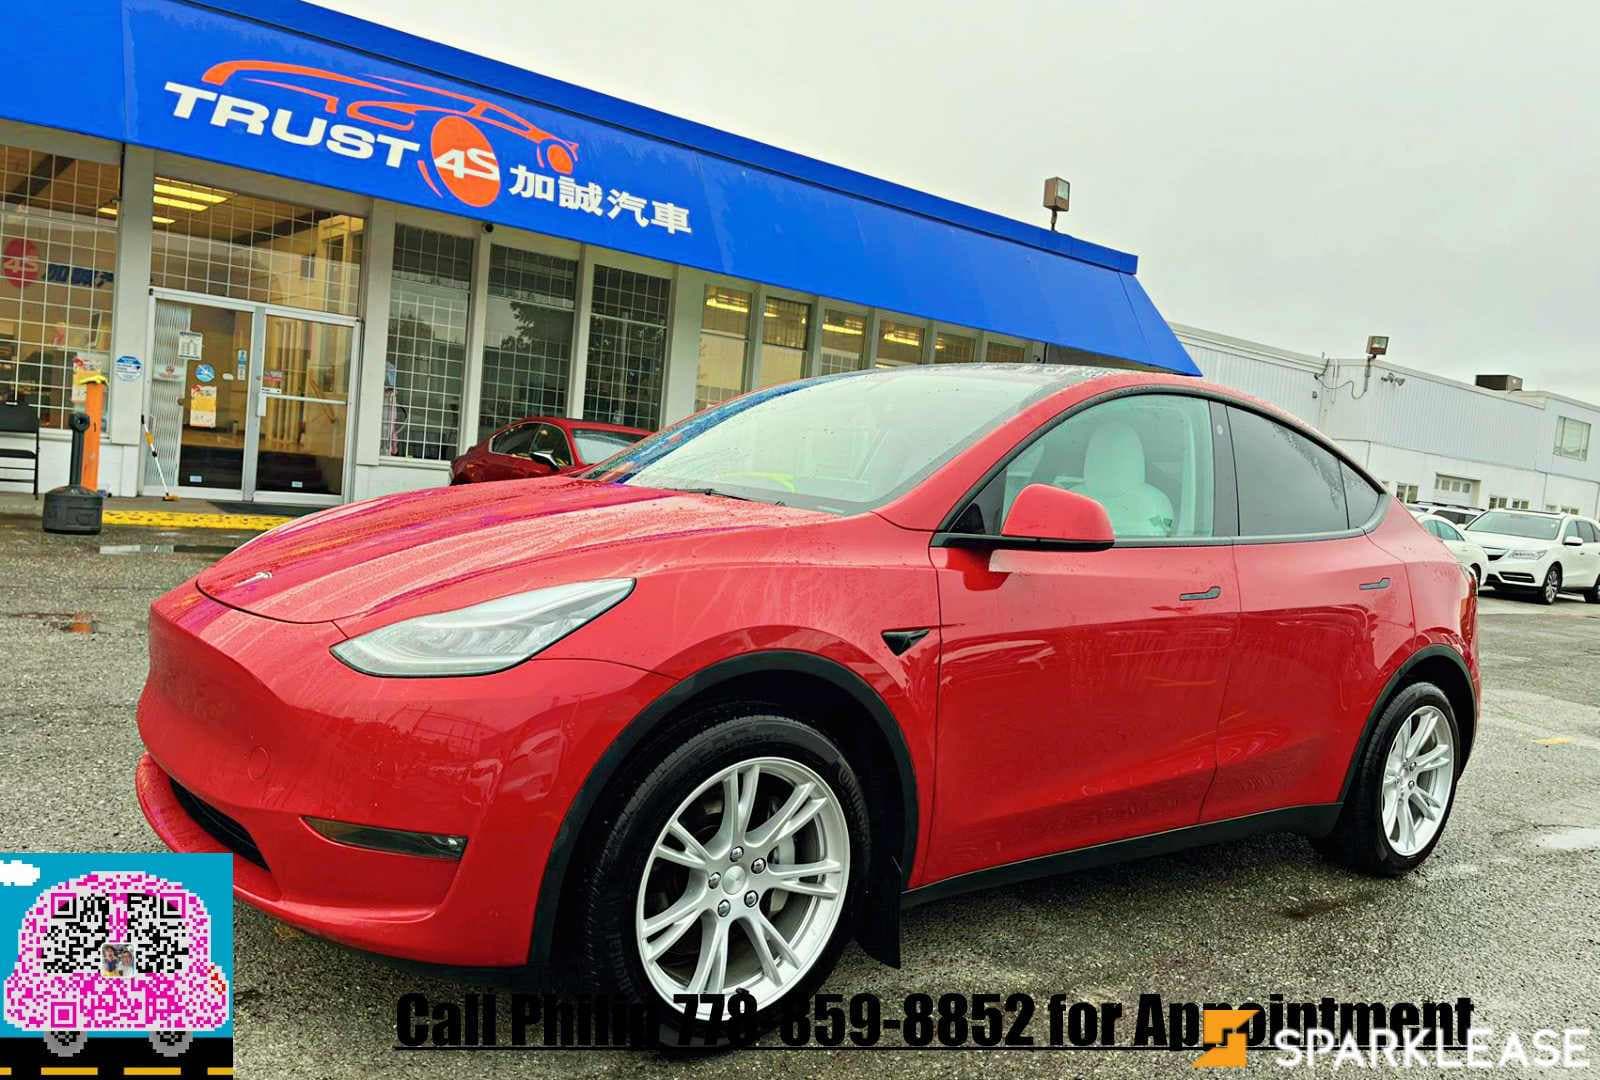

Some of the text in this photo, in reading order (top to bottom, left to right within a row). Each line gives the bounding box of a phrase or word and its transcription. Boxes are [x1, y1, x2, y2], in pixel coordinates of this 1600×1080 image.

[164, 81, 500, 181] TRUST 4S
[508, 164, 692, 235] 加誠汽車
